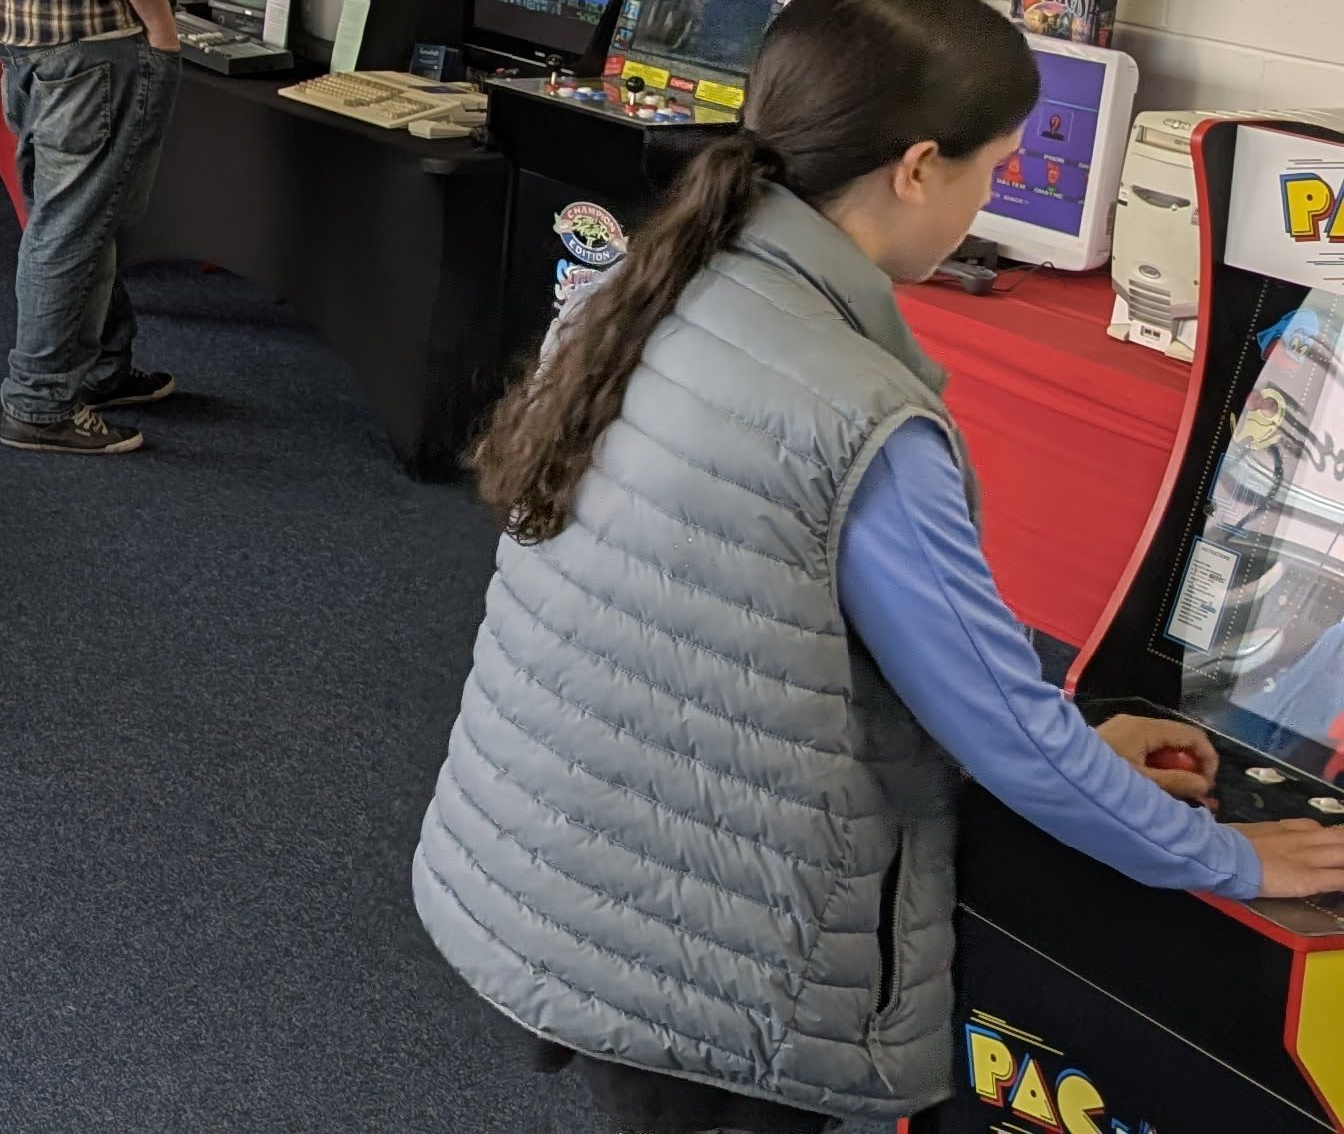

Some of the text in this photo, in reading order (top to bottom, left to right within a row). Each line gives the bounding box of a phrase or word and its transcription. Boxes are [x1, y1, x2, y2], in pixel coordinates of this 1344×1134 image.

[567, 205, 616, 233] CHAMPION
[1279, 172, 1344, 244] P
[568, 239, 610, 261] EDITION
[965, 1023, 1156, 1134] PAC
